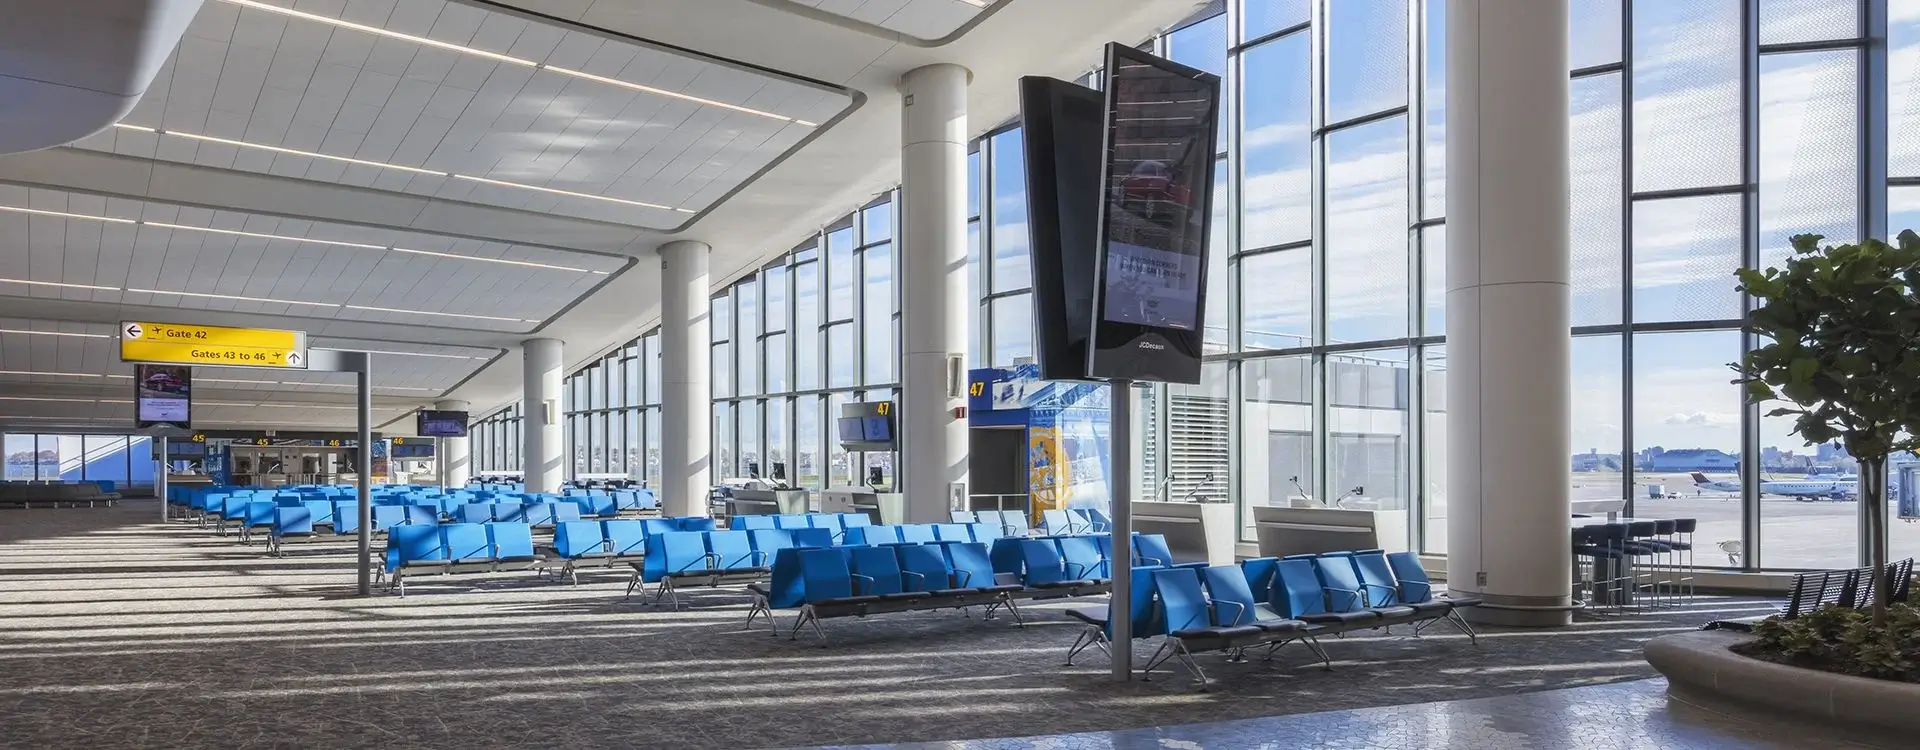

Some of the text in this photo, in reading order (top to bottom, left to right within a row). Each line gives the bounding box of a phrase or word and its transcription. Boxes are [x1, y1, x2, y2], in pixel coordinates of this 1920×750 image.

[166, 329, 207, 339] Gate 42
[1138, 341, 1165, 350] JCDecaux
[191, 349, 266, 361] Gates 43 to 46
[970, 382, 984, 396] 47
[877, 402, 889, 415] 47
[192, 434, 204, 442] 45
[257, 438, 269, 446] 45
[393, 437, 404, 445] 46
[329, 439, 340, 447] 46
